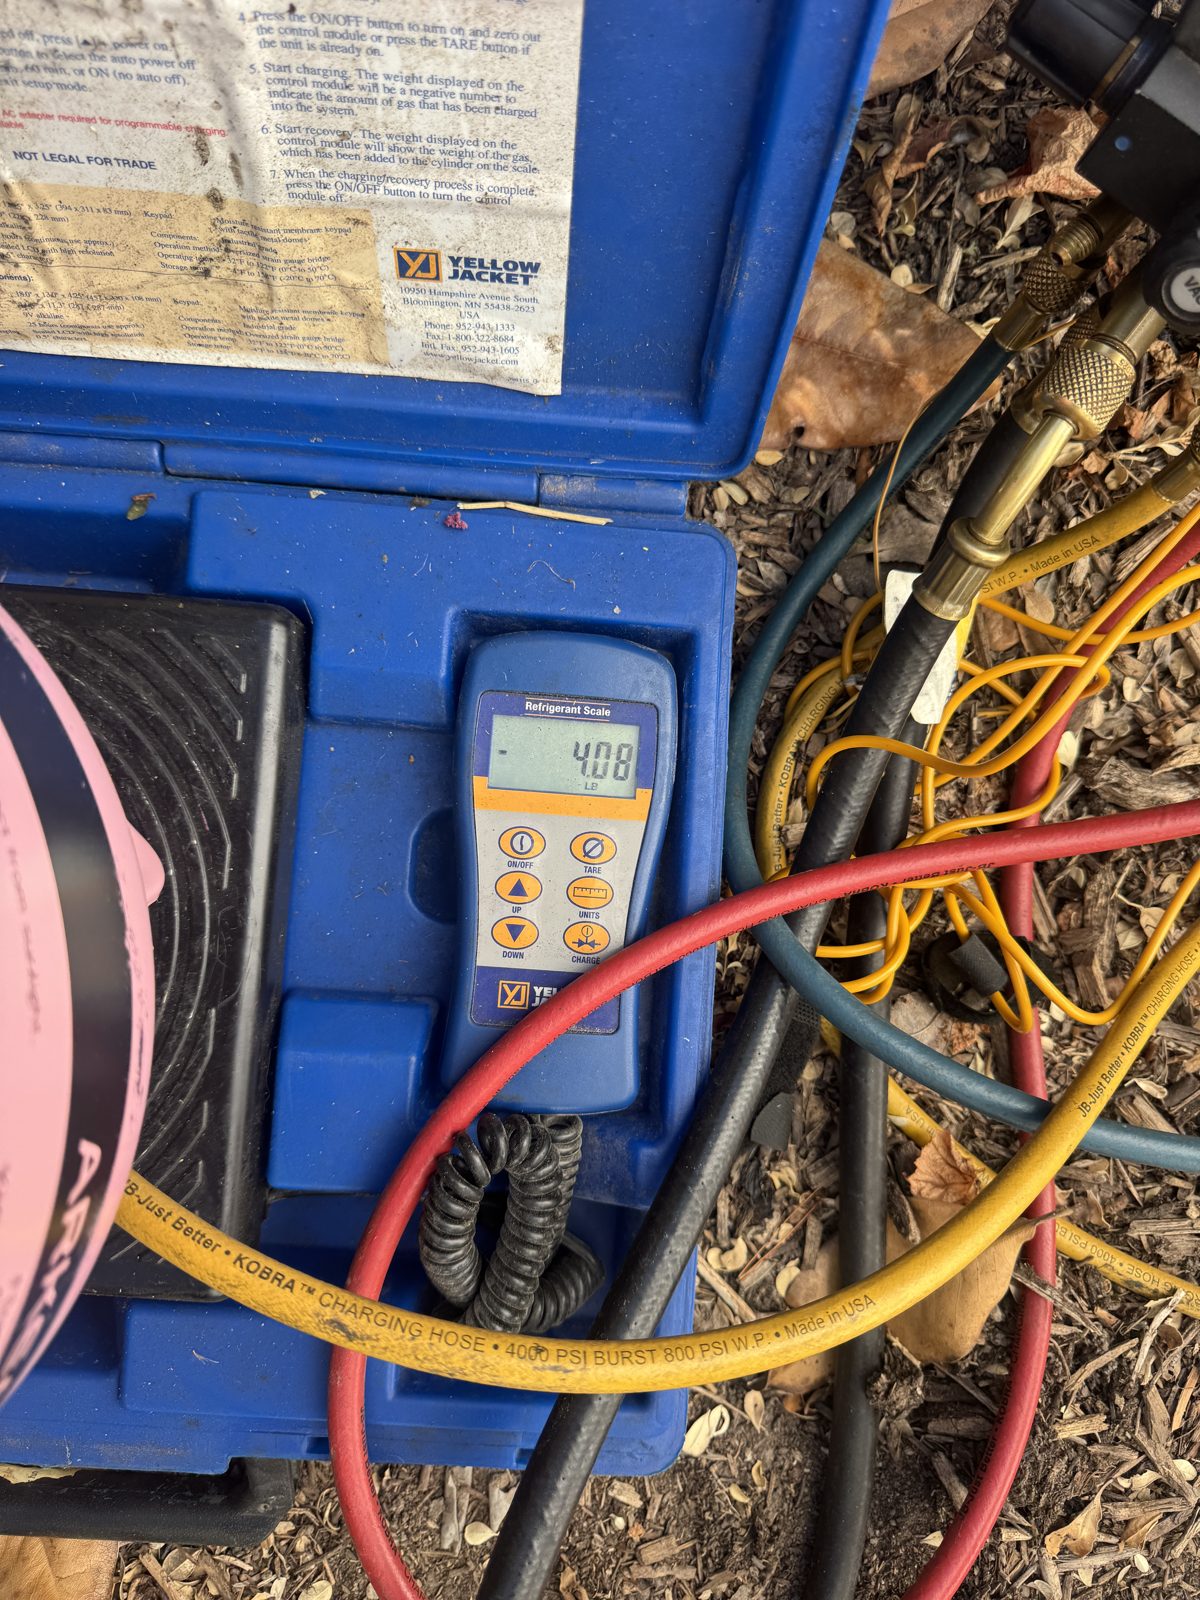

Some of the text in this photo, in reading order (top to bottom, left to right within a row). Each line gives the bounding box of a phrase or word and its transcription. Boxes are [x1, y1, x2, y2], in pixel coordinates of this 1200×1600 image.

[310, 12, 519, 41] ON/OFF button and zero
[278, 27, 517, 54] control module press the TARE button
[281, 40, 361, 57] unit already
[111, 55, 196, 70] auto power off
[89, 66, 161, 83] ON (no auto
[264, 63, 525, 92] Start charging. The weight displayed on the
[266, 76, 501, 103] control module will negative number
[268, 88, 538, 120] indicate the amount gas that has been charged
[271, 102, 358, 116] into the system.
[58, 114, 97, 125] required
[114, 119, 182, 132] programmable
[275, 123, 517, 150] Start recovery. The weight displayed on the
[277, 136, 475, 160] control module will show the weight
[12, 150, 157, 170] NOT LEGAL FOR TRADE
[280, 148, 540, 174] which has been added the cylinder the scale.
[283, 169, 473, 191] When the charging/recovery process
[286, 180, 511, 206] press the ON/OFF button turn the control
[288, 191, 326, 202] module
[154, 241, 190, 251] Operation
[160, 262, 188, 271] Storage
[448, 255, 541, 274] YELLOW
[400, 286, 427, 296] 10950
[429, 289, 476, 300] Hampshire
[479, 292, 510, 302] Avenue
[459, 311, 481, 320] USA
[464, 301, 482, 309] MN
[484, 302, 536, 313] 55438-2623
[424, 321, 516, 332] Phone: 952-943-1333
[425, 332, 514, 343] Fax: 1-800-322-8684
[422, 350, 519, 366] www.yellowjacket.com
[461, 344, 520, 355] 952-943-1605
[994, 535, 1101, 588] W.P. Made in USA
[525, 701, 611, 717] Refrigerant Scale
[797, 685, 837, 740] CHARGING
[573, 740, 634, 781] 4.08
[584, 782, 599, 791] LB
[507, 860, 534, 870] ON/OFF
[584, 865, 602, 875] TARE
[512, 906, 522, 914] UP
[578, 911, 600, 920] UNITS
[502, 951, 525, 960] DOWN
[571, 955, 601, 965] CHARGE
[1079, 1080, 1107, 1118] JB-Just
[1101, 1056, 1124, 1084] Better
[1146, 971, 1180, 1016] CHARGING
[1177, 951, 1197, 976] HOSE
[1068, 1234, 1161, 1288] HOSE 4000 PSI
[125, 1178, 172, 1223] B-Just
[171, 1208, 222, 1254] Better
[318, 1291, 424, 1338] CHARGING
[429, 1326, 486, 1353] HOSE
[505, 1342, 549, 1363] 4000
[556, 1348, 587, 1366] PSI
[593, 1349, 657, 1367] BURST
[664, 1344, 695, 1364] 800
[698, 1339, 730, 1360] PSI
[734, 1331, 770, 1353] W.P.
[784, 1316, 826, 1340] Made
[828, 1311, 841, 1326] in
[843, 1294, 877, 1320] USA
